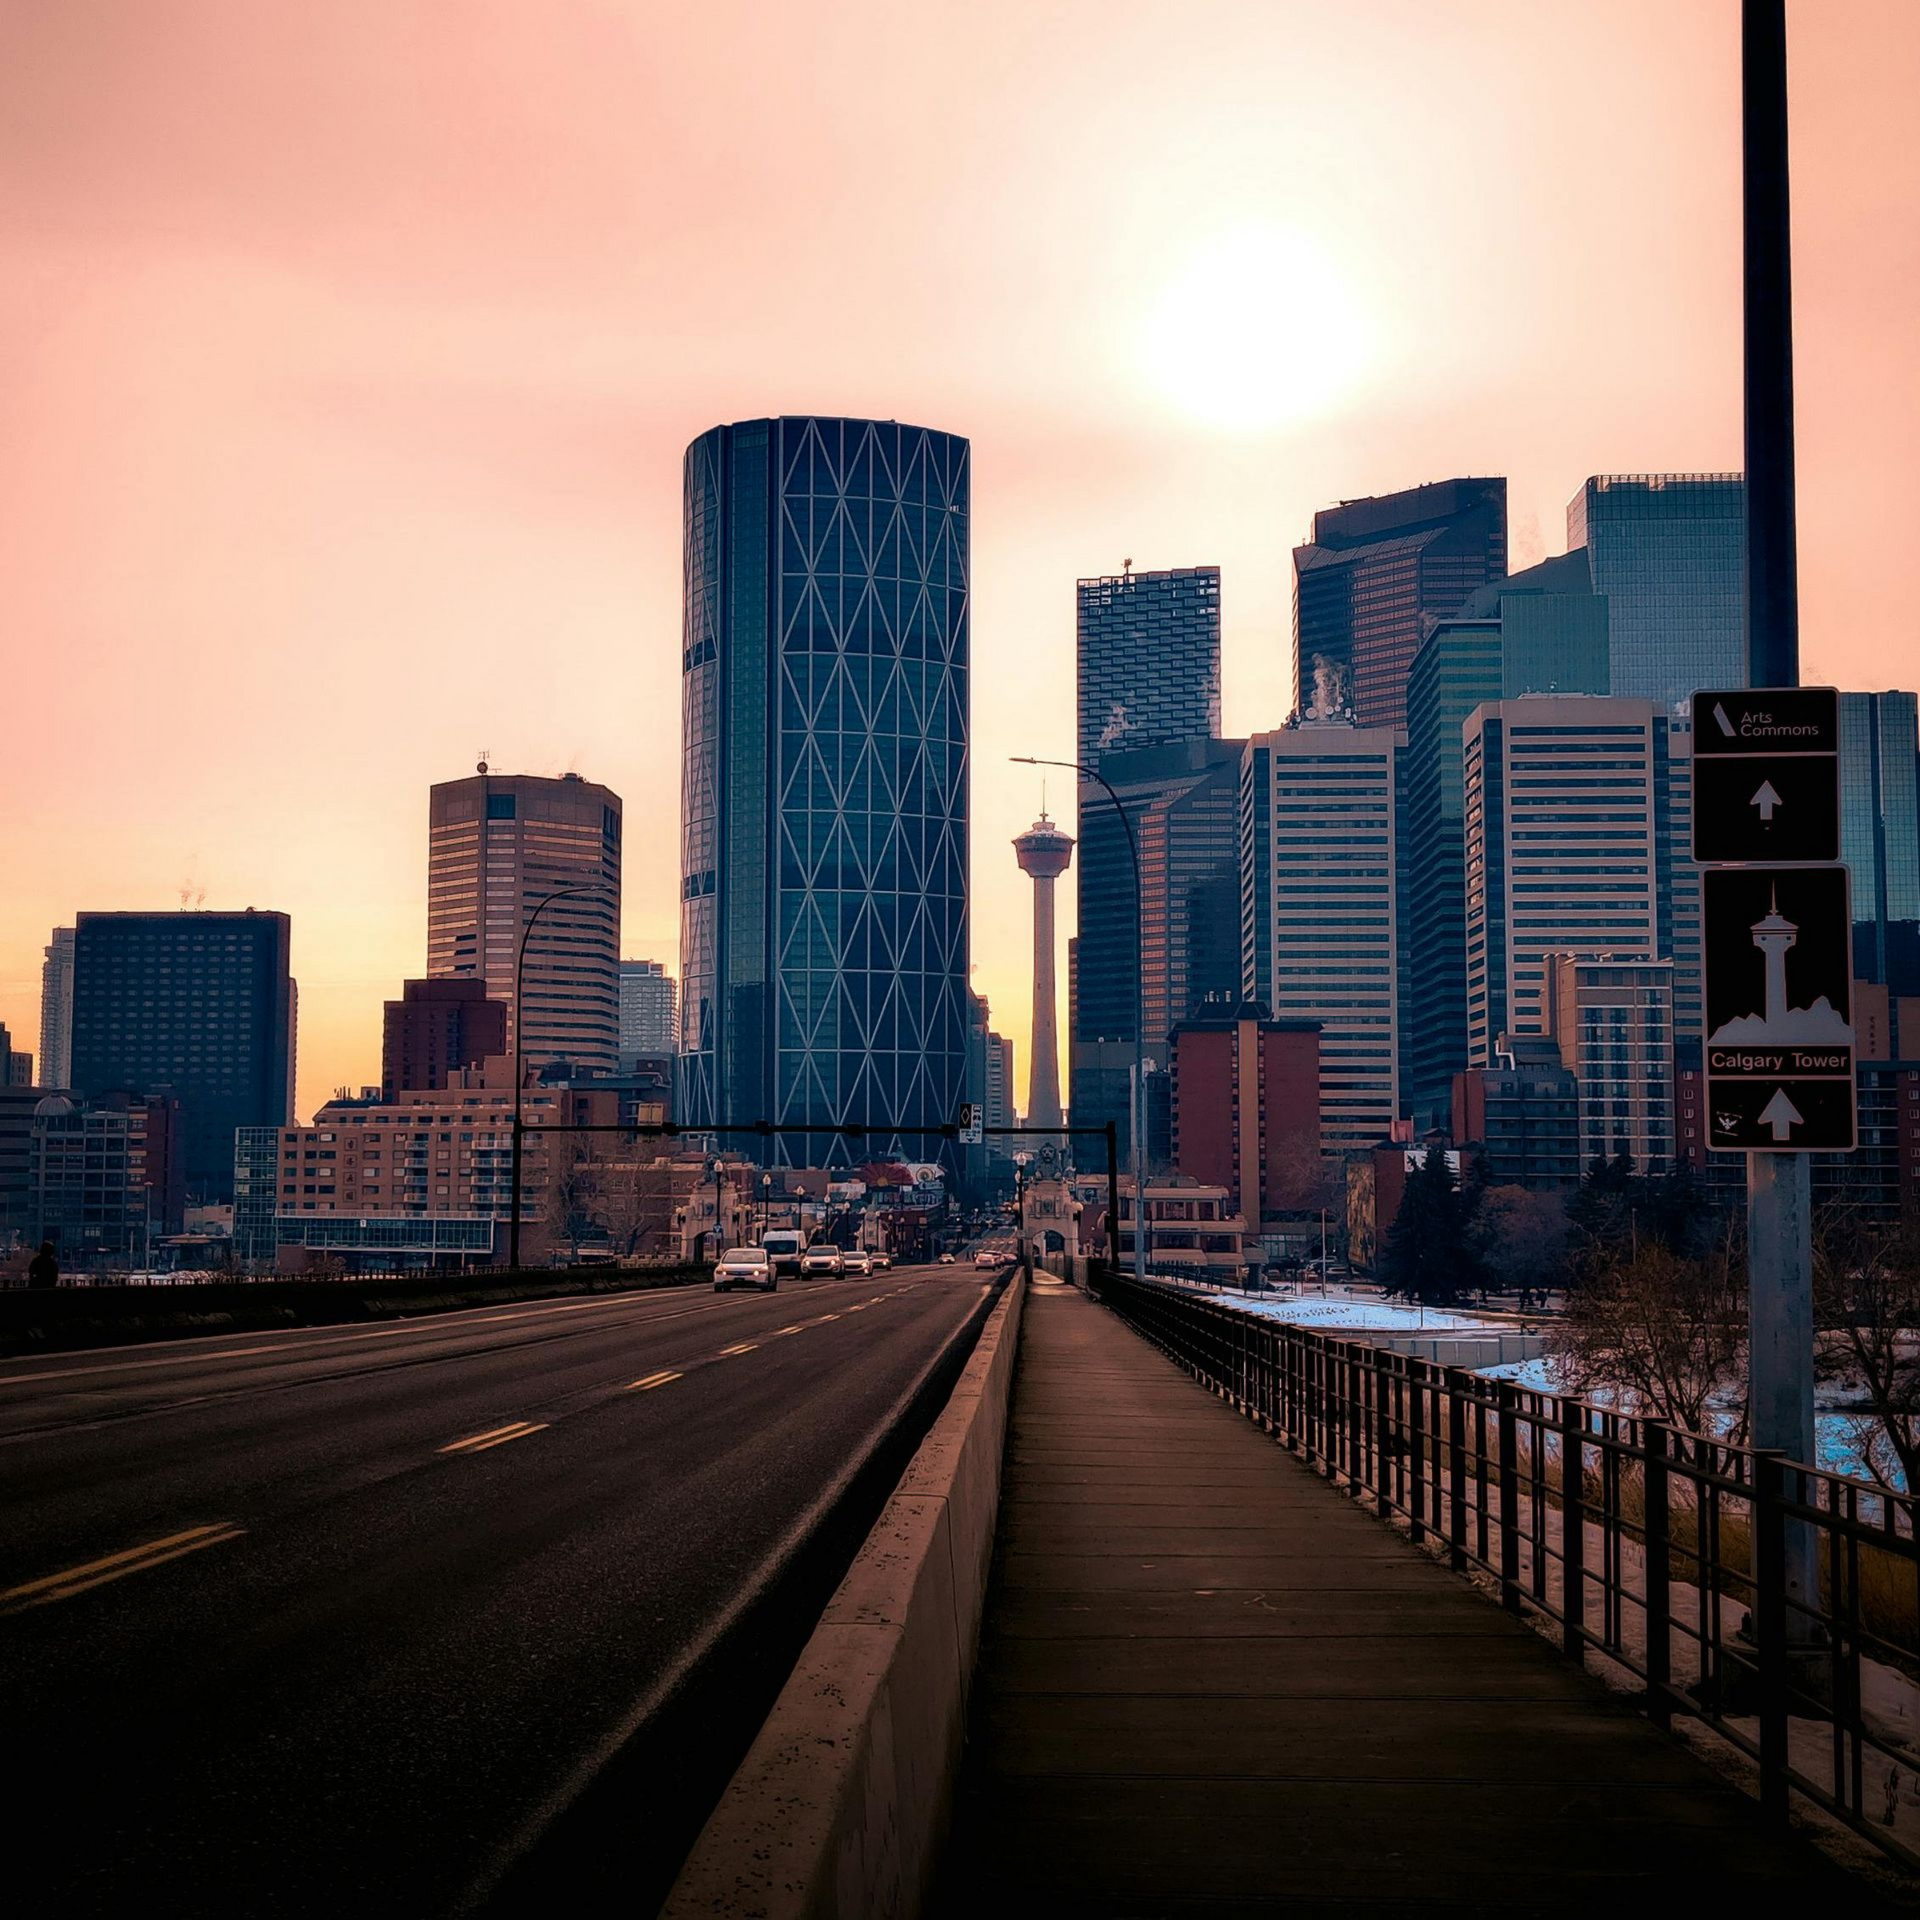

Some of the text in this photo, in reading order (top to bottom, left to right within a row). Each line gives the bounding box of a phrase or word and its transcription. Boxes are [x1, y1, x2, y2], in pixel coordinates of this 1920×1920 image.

[1741, 712, 1773, 723] Arts
[1740, 724, 1819, 737] Commons
[1711, 1052, 1848, 1071] Calgary Tower
